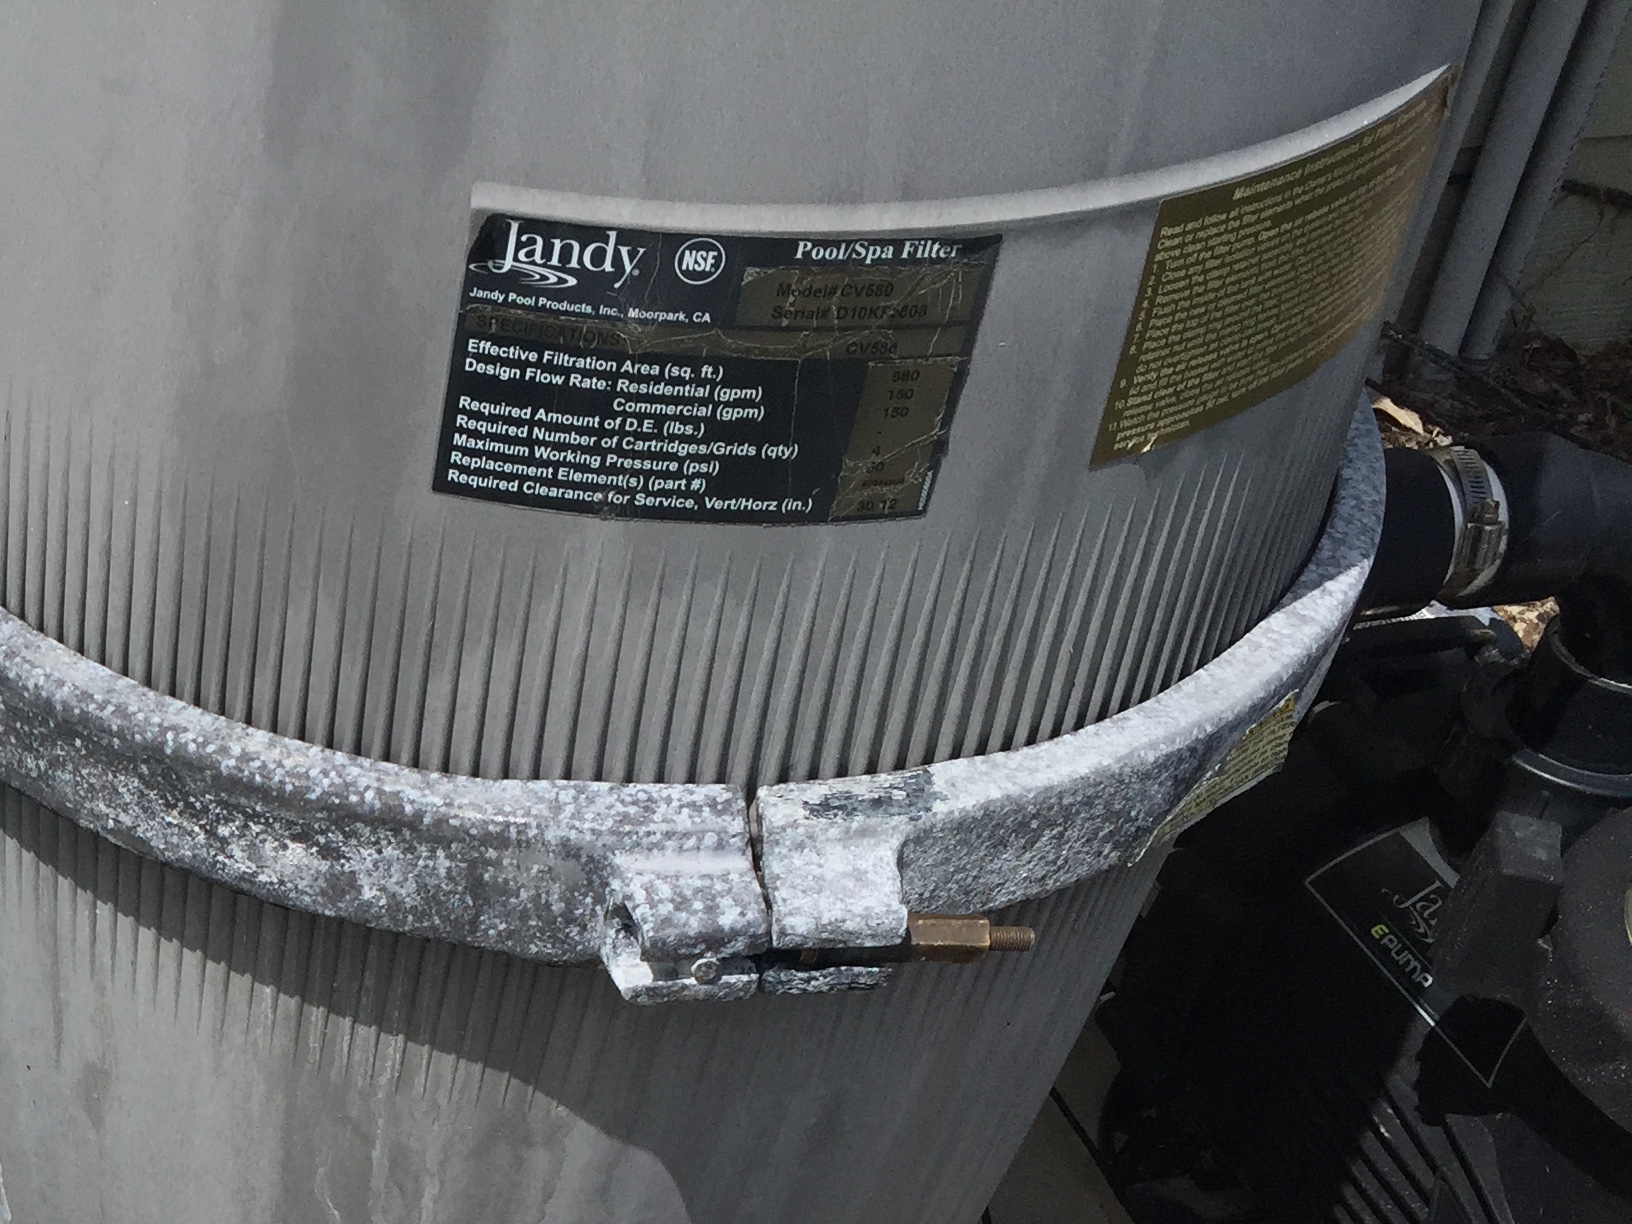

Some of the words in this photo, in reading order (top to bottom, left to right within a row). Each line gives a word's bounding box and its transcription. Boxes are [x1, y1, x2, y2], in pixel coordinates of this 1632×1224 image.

[487, 219, 646, 289] Jandy
[681, 249, 718, 272] NSF
[794, 240, 894, 264] Pool/Spa
[900, 239, 962, 259] Filter
[469, 287, 505, 303] Jandy
[508, 292, 535, 306] Pool
[538, 297, 596, 316] Products,
[598, 304, 624, 318] Inc.,
[627, 307, 689, 323] Moorpark,
[692, 312, 711, 323] CA
[476, 314, 622, 346] SPECIFICATIONS
[464, 358, 520, 381] Design
[524, 368, 566, 385] Flow
[569, 373, 612, 391] Rate:
[616, 378, 710, 398] Residential
[714, 385, 763, 402] (gpm)
[467, 338, 539, 362] Effective
[542, 350, 617, 373] Filtration
[620, 359, 660, 376] Area
[664, 362, 695, 381] (sq.
[700, 364, 724, 382] ft.)
[891, 369, 921, 383] 580
[458, 395, 532, 419] Required
[534, 408, 600, 428] Amount
[604, 417, 623, 431] of
[625, 418, 658, 433] D.E.
[663, 421, 705, 439] (lbs.)
[612, 397, 712, 417] Commercial
[716, 404, 765, 422] (gpm)
[884, 406, 910, 419] 150
[452, 433, 529, 457] Maximum
[534, 445, 601, 469] Working
[605, 454, 679, 471] Pressure
[683, 459, 720, 476] (psi)
[456, 414, 529, 438] Required
[532, 427, 597, 447] Number
[601, 436, 619, 449] of
[622, 436, 757, 456] Cartridges/Grids
[761, 443, 799, 460] (qty)
[447, 468, 519, 492] Required
[522, 481, 603, 502] Clearance
[607, 490, 631, 504] for
[634, 492, 699, 510] Service,
[704, 496, 778, 510] Vert/Horz
[781, 497, 813, 514] (in.)
[450, 451, 554, 478] Replacement
[557, 467, 644, 491] Element(s)
[648, 475, 687, 492] (part
[690, 477, 706, 494] #)
